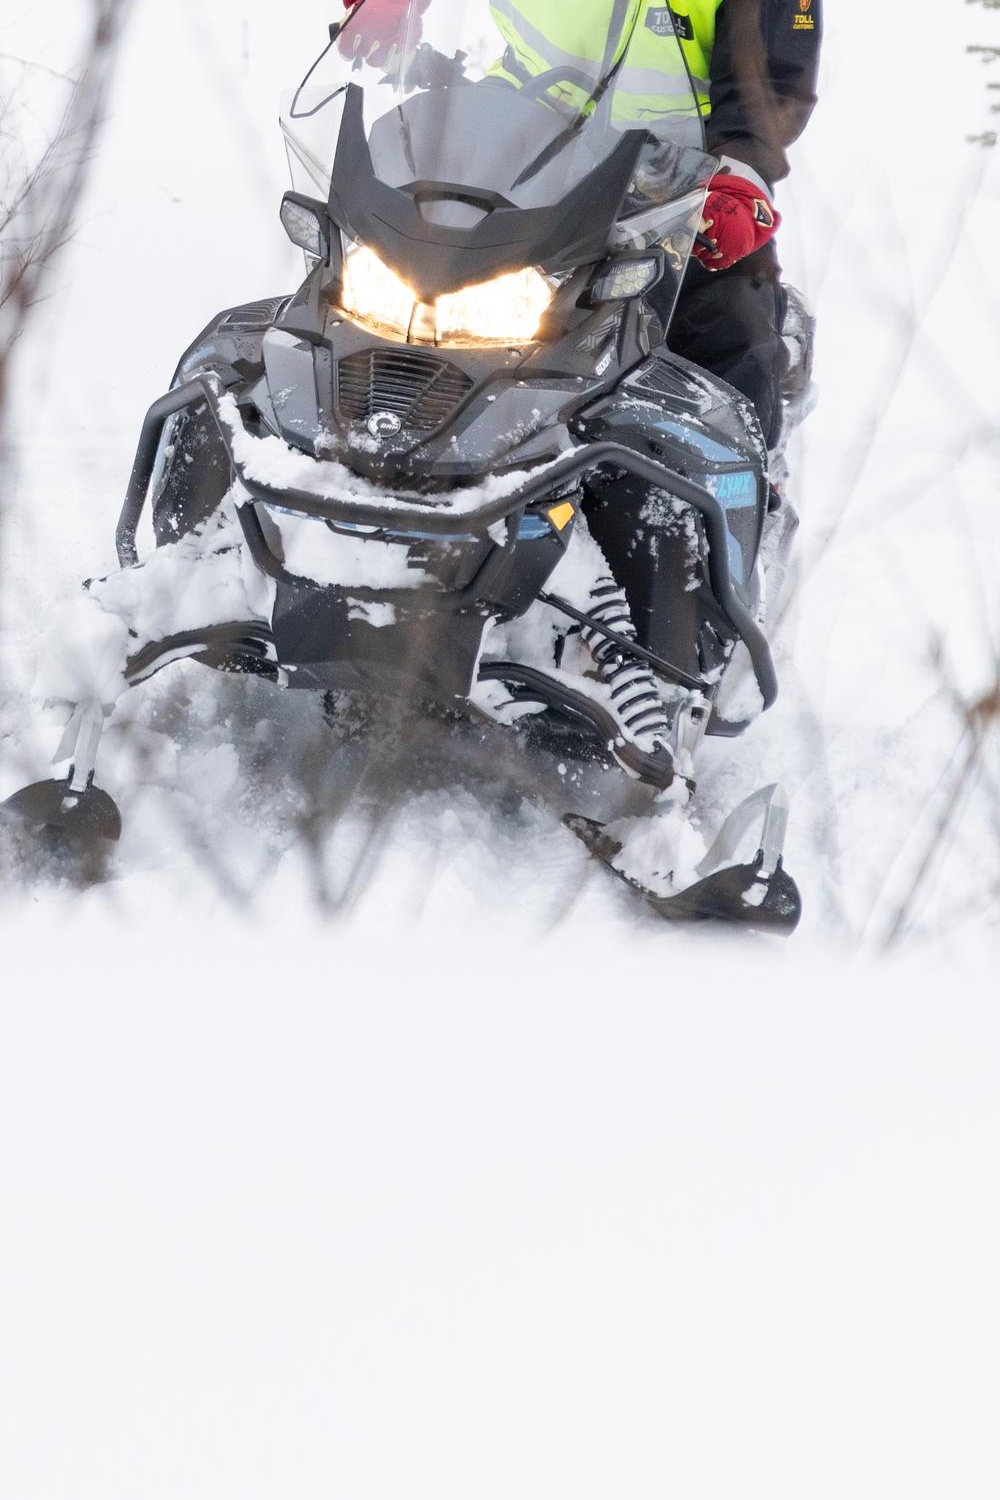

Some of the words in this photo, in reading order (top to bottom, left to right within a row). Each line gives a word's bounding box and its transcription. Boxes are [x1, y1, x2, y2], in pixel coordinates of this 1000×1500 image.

[655, 11, 686, 31] TOL
[794, 14, 815, 24] TOLL
[716, 473, 751, 499] LYNX
